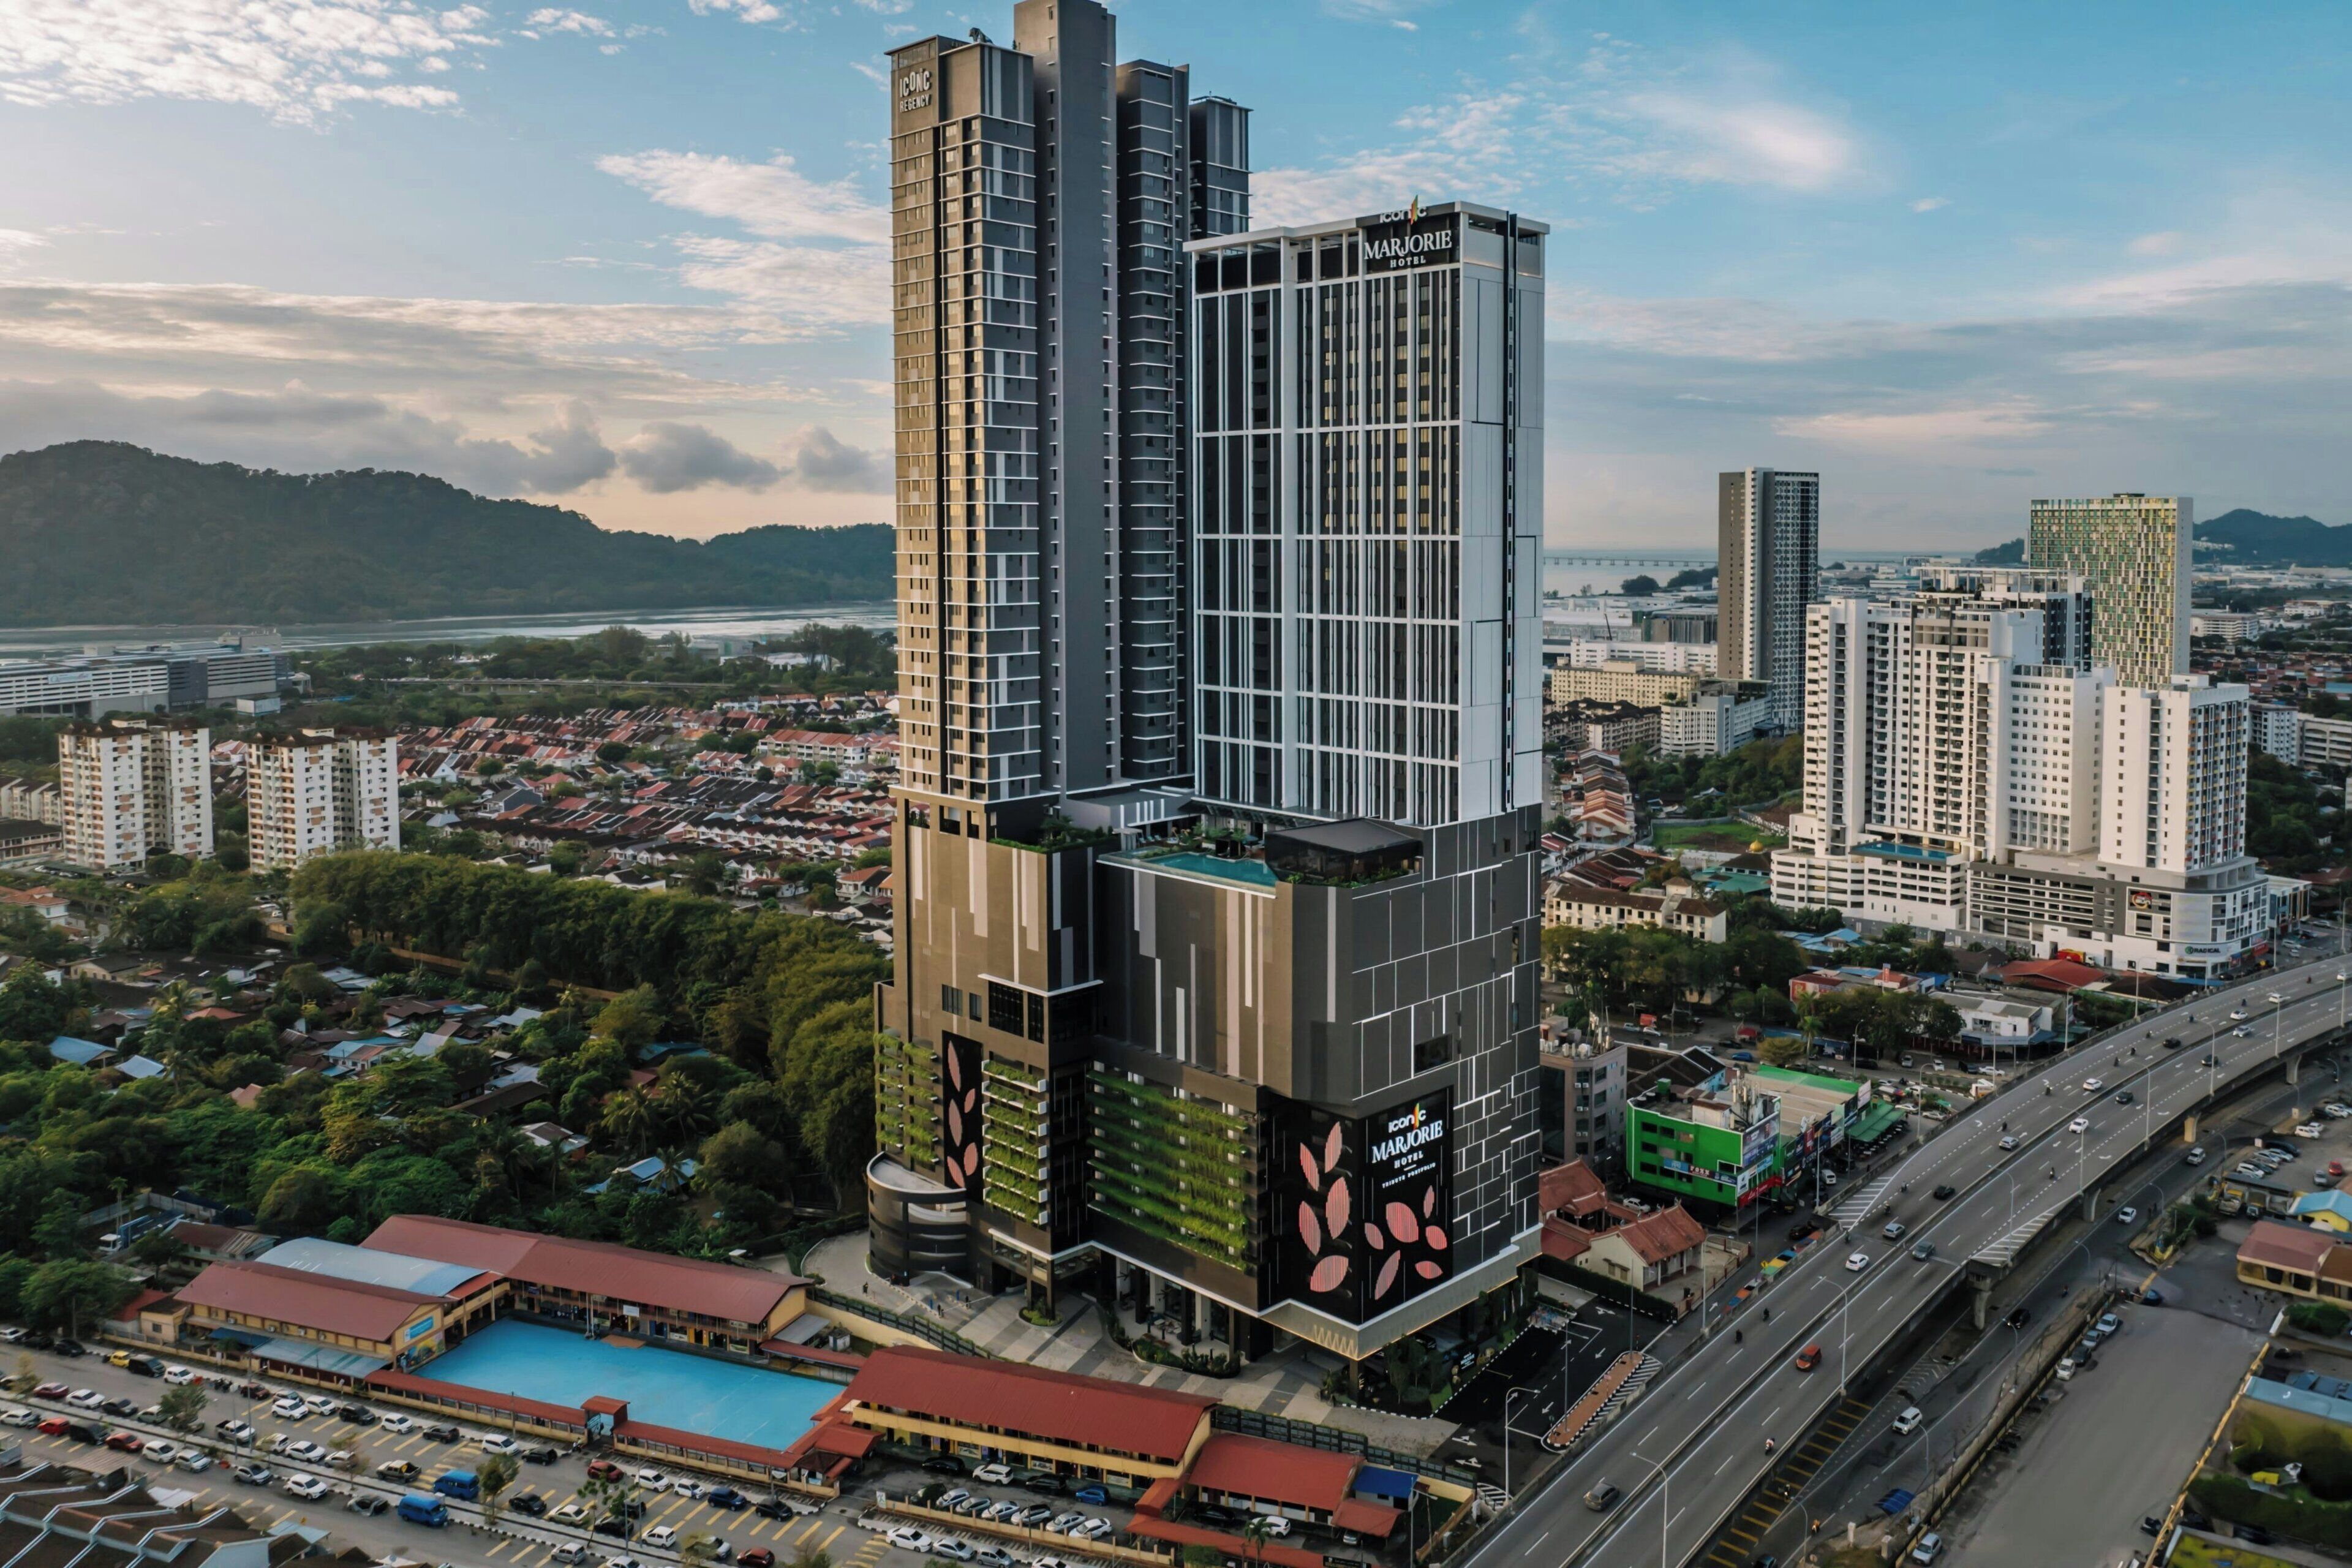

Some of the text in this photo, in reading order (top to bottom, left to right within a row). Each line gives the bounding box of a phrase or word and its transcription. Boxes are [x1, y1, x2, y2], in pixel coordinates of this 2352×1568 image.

[900, 94, 930, 113] REGENCY
[1364, 230, 1452, 260] MARJORIE
[1390, 255, 1427, 268] HOTEL
[1371, 1120, 1443, 1164] MARJORIE
[1394, 1150, 1424, 1169] HOTEL
[1382, 1162, 1436, 1189] TRIBUTE PORTFOLIO
